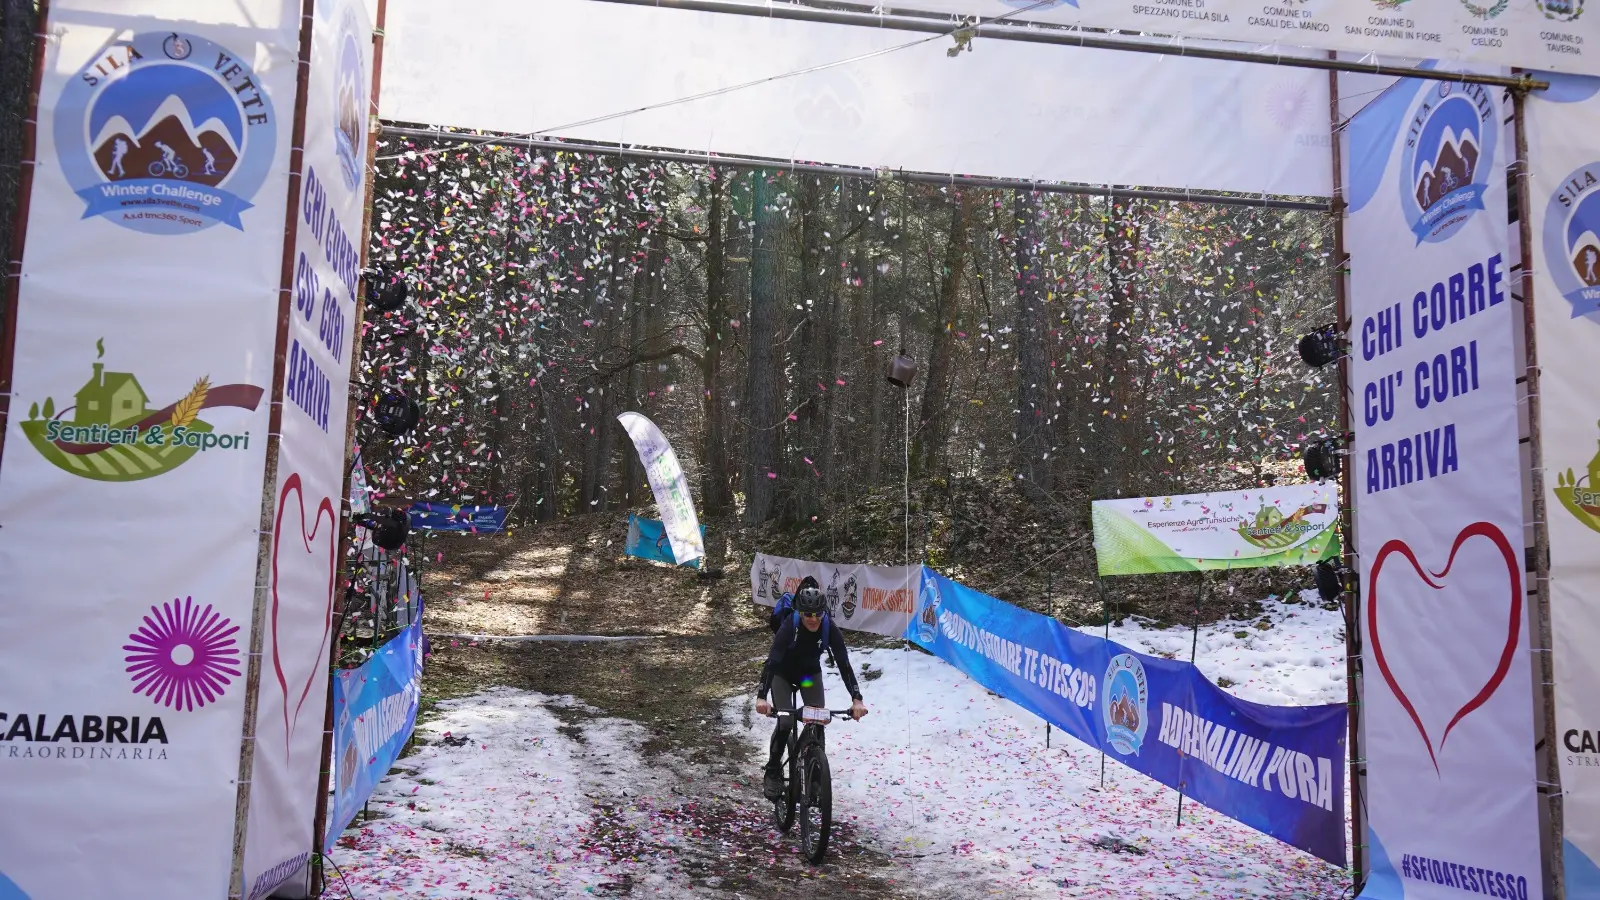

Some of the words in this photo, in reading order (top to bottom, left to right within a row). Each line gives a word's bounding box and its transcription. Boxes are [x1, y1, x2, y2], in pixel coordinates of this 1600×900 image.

[1132, 5, 1180, 18] SPEZZANO
[1181, 10, 1209, 21] DELLA
[1211, 12, 1230, 23] SILA
[1248, 16, 1279, 28] CASALI
[1280, 20, 1298, 29] DEL
[1299, 21, 1330, 32] MANCO
[1263, 6, 1300, 18] COMUNE
[1302, 10, 1312, 18] DI
[1368, 16, 1405, 28] COMUNE
[1406, 19, 1415, 28] DI
[1344, 25, 1362, 36] SAN
[1363, 27, 1404, 39] GIOVANNI
[1405, 30, 1414, 40] IN
[1416, 31, 1441, 42] FIORE
[1462, 25, 1499, 36] COMUNE
[1500, 28, 1509, 37] DI
[1471, 37, 1503, 48] CELICO
[1540, 31, 1575, 43] COMUNE
[1575, 36, 1584, 45] DI
[1547, 43, 1582, 55] TAVERNA
[82, 45, 143, 87] SILA
[212, 51, 269, 126] VETTE
[1407, 103, 1431, 149] SILA
[101, 184, 150, 198] Winter
[151, 184, 223, 206] Challenge
[1558, 170, 1598, 208] SILA
[178, 215, 203, 227] Sport
[303, 165, 327, 247] CHI
[325, 207, 359, 303] CORRE
[1361, 302, 1403, 362] CHI
[1412, 252, 1505, 339] CORRE
[319, 286, 346, 367] CORI
[286, 338, 332, 434] ARRIVA
[1414, 339, 1480, 410] CORI
[46, 420, 140, 445] Sentieri
[144, 424, 165, 446] &
[171, 425, 250, 451] Sapori
[1366, 423, 1459, 495] ARRIVA
[1147, 520, 1186, 530] Esperienze
[1186, 518, 1204, 527] Agro
[1205, 514, 1241, 525] Turistiche
[1295, 521, 1325, 533] Sapori
[980, 629, 1023, 676] SFIDARE
[1024, 646, 1039, 684] TE
[1038, 653, 1097, 711] STESSO?
[1564, 729, 1600, 753] CA
[1158, 702, 1271, 788] ADRENALINA
[1262, 745, 1333, 812] PURA
[1401, 853, 1528, 900] #SFIDATESTESSO
